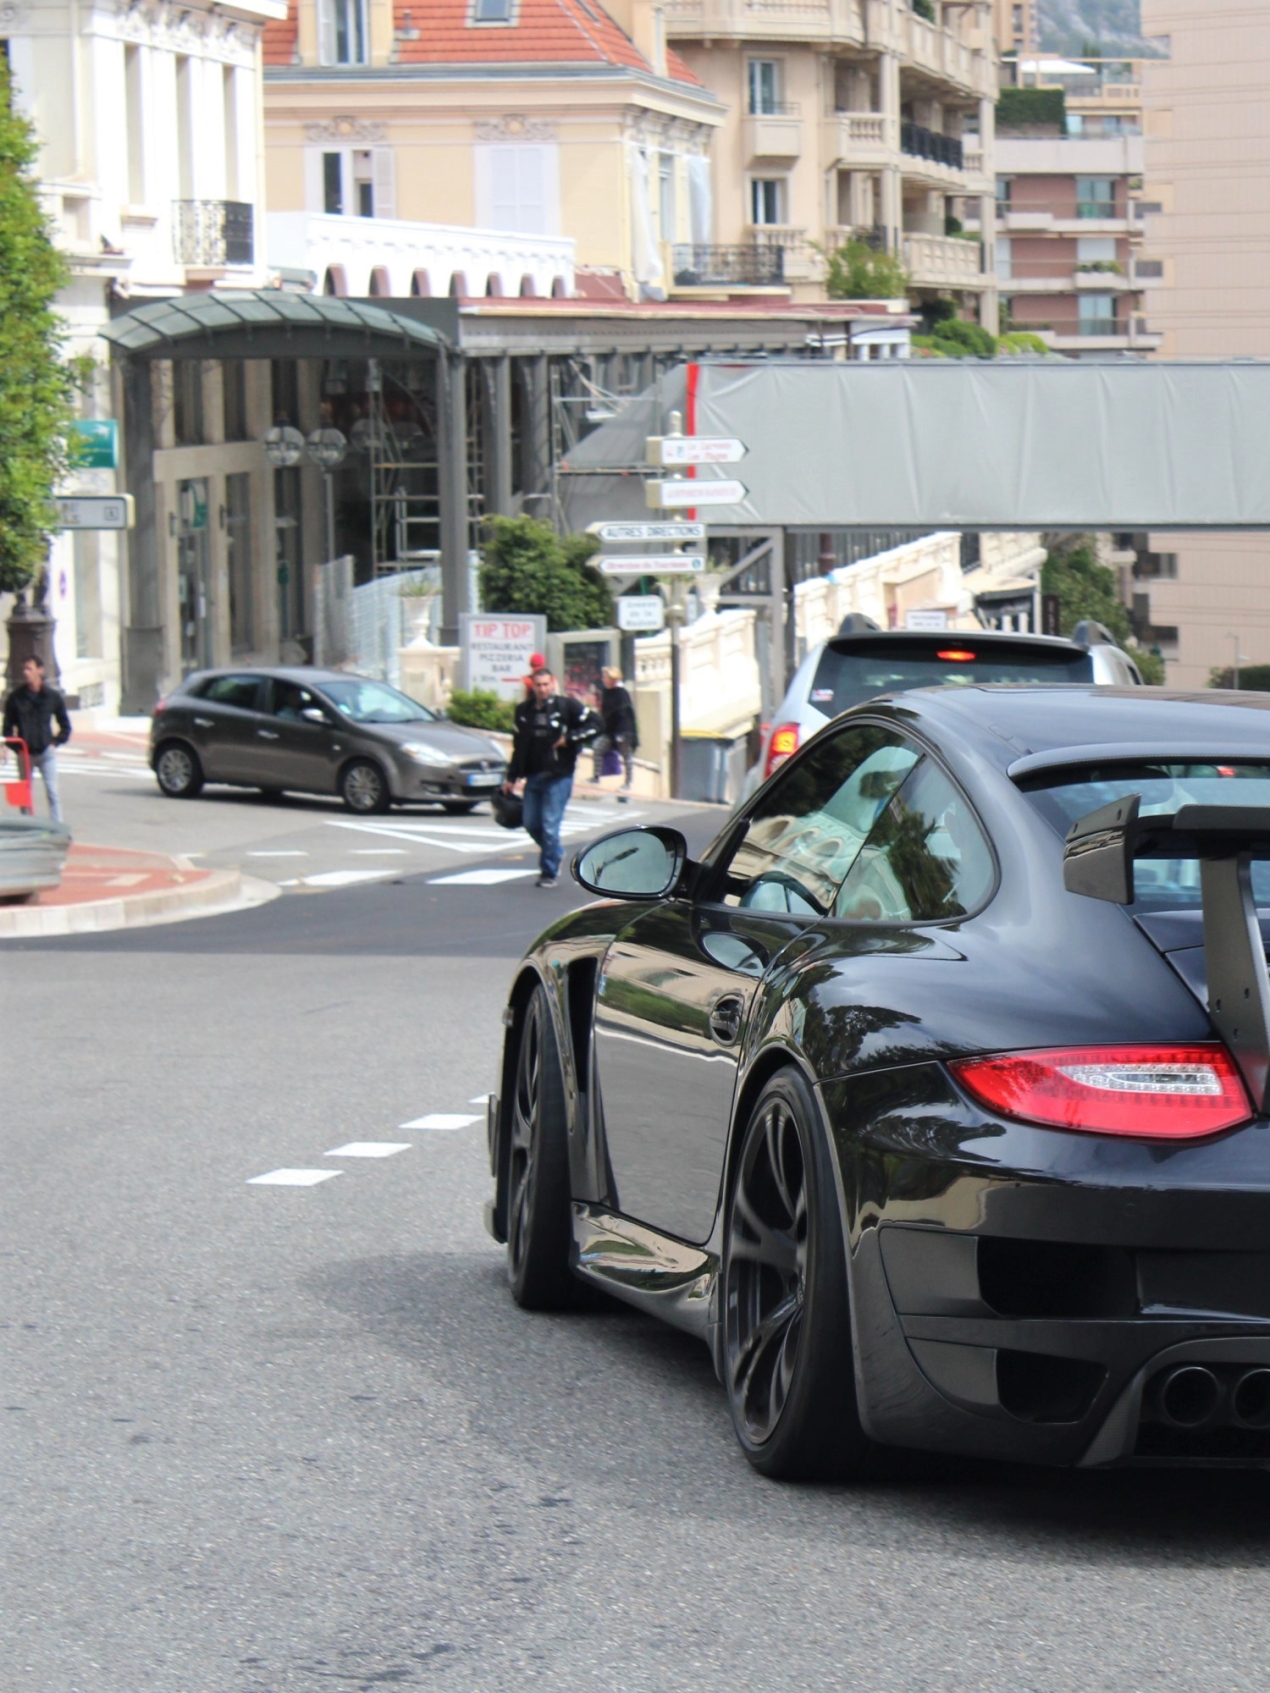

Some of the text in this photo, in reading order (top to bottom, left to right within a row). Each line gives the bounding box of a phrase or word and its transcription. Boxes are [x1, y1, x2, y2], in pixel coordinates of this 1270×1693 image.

[607, 525, 701, 538] AUTRES DIRECTIONS
[473, 622, 532, 640] TIP TOP
[471, 642, 533, 652] RESTAURANT
[479, 653, 525, 663] PIZZERIA
[491, 664, 512, 673] BAR
